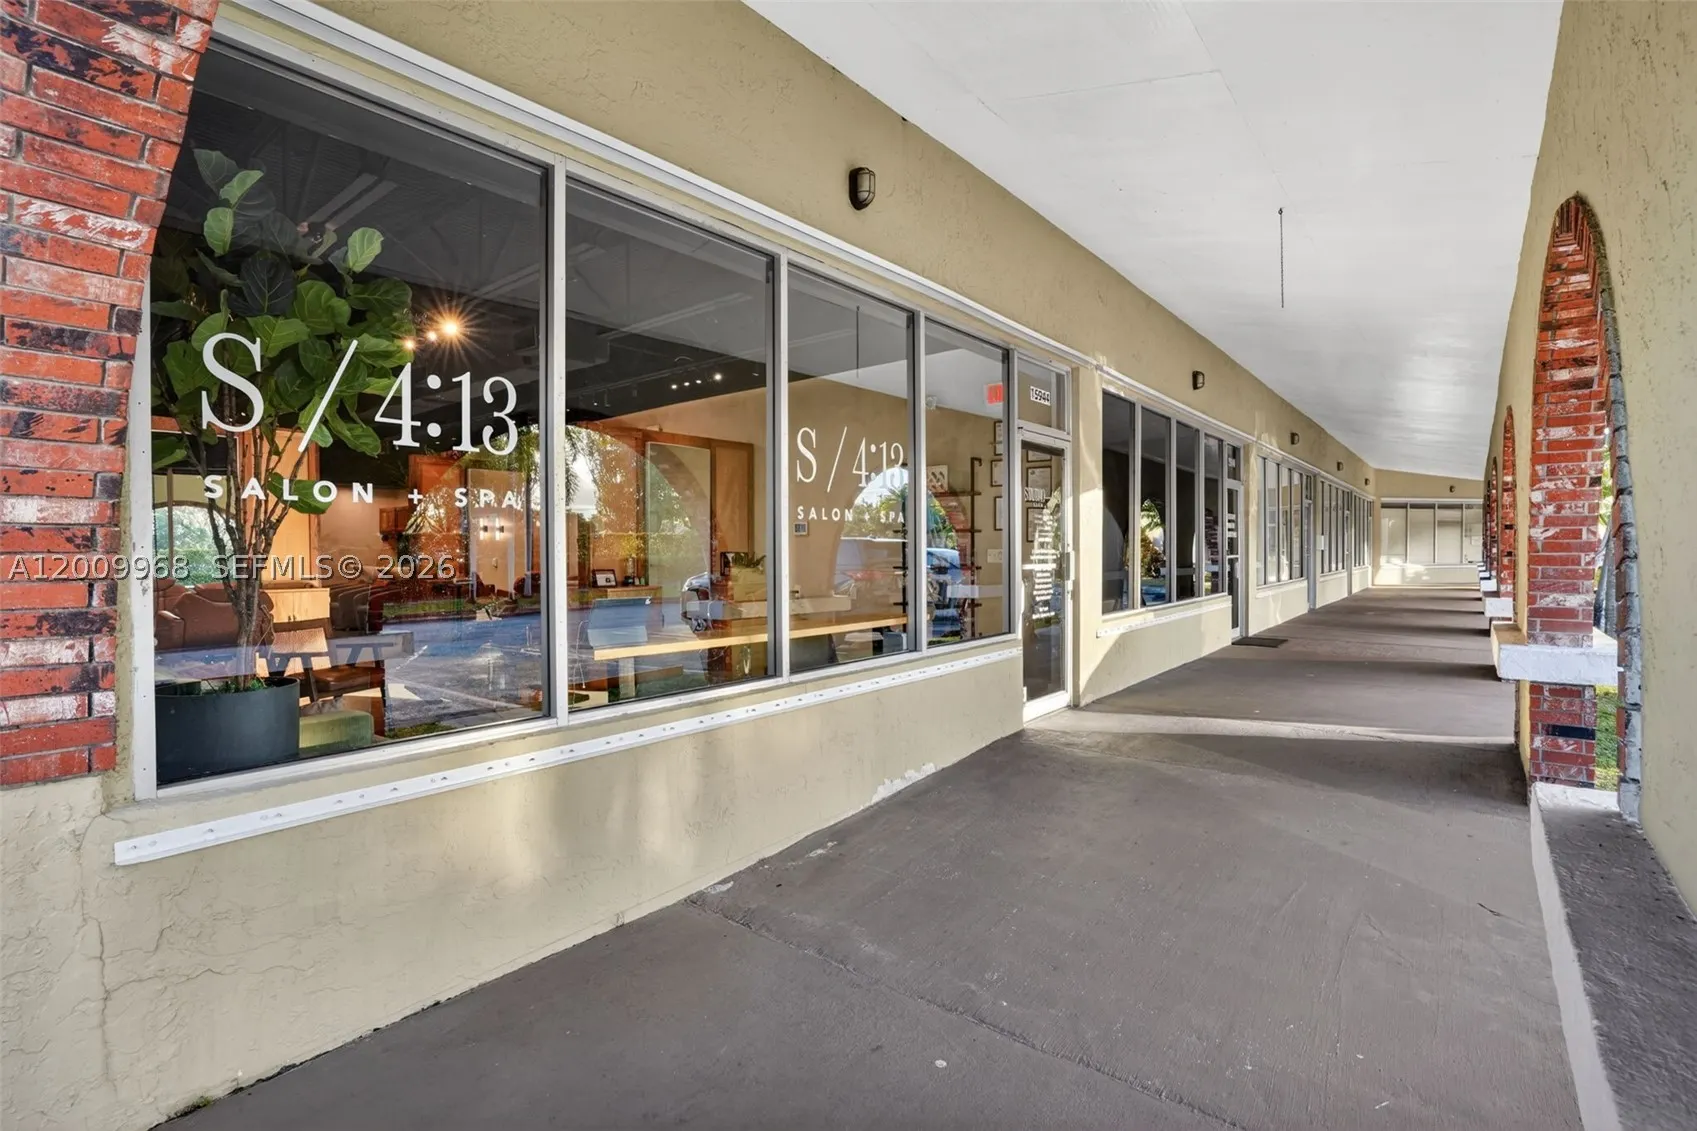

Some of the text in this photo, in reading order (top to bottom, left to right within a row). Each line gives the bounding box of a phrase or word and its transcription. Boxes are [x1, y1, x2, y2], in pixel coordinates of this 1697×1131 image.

[201, 332, 264, 433] S
[374, 362, 519, 456] 4:13
[796, 427, 818, 483] S
[203, 475, 520, 511] SALON + SPA
[797, 506, 853, 522] SALON
[880, 511, 905, 523] SPA
